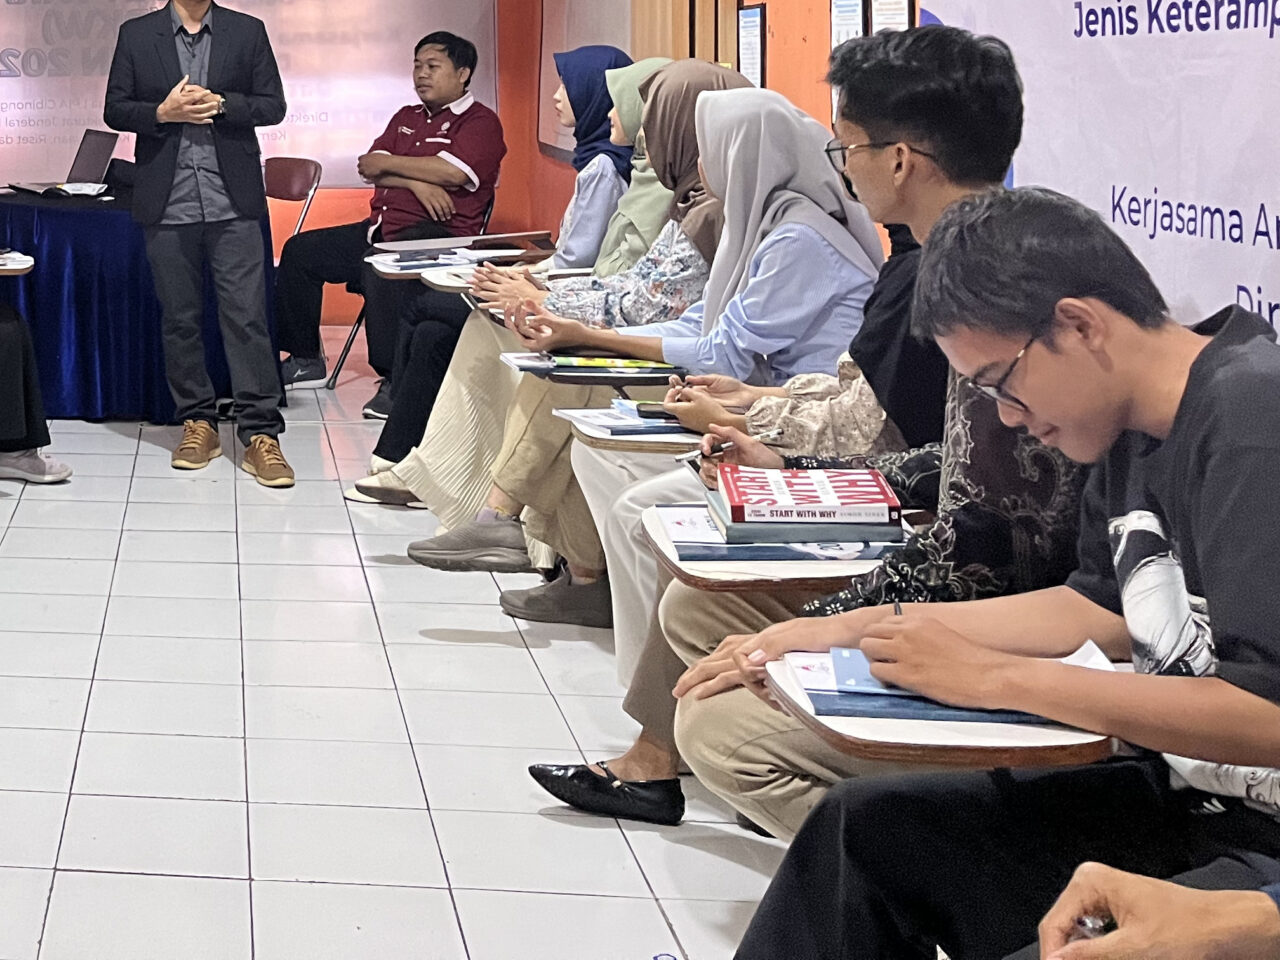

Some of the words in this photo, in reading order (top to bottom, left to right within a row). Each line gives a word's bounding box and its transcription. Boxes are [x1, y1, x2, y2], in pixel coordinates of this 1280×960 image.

[1111, 185, 1243, 244] Kerjasama
[733, 469, 778, 507] START
[780, 468, 823, 506] WITH
[824, 468, 889, 507] WHY
[769, 509, 794, 518] START
[796, 509, 819, 518] WITH
[819, 510, 837, 519] WHY
